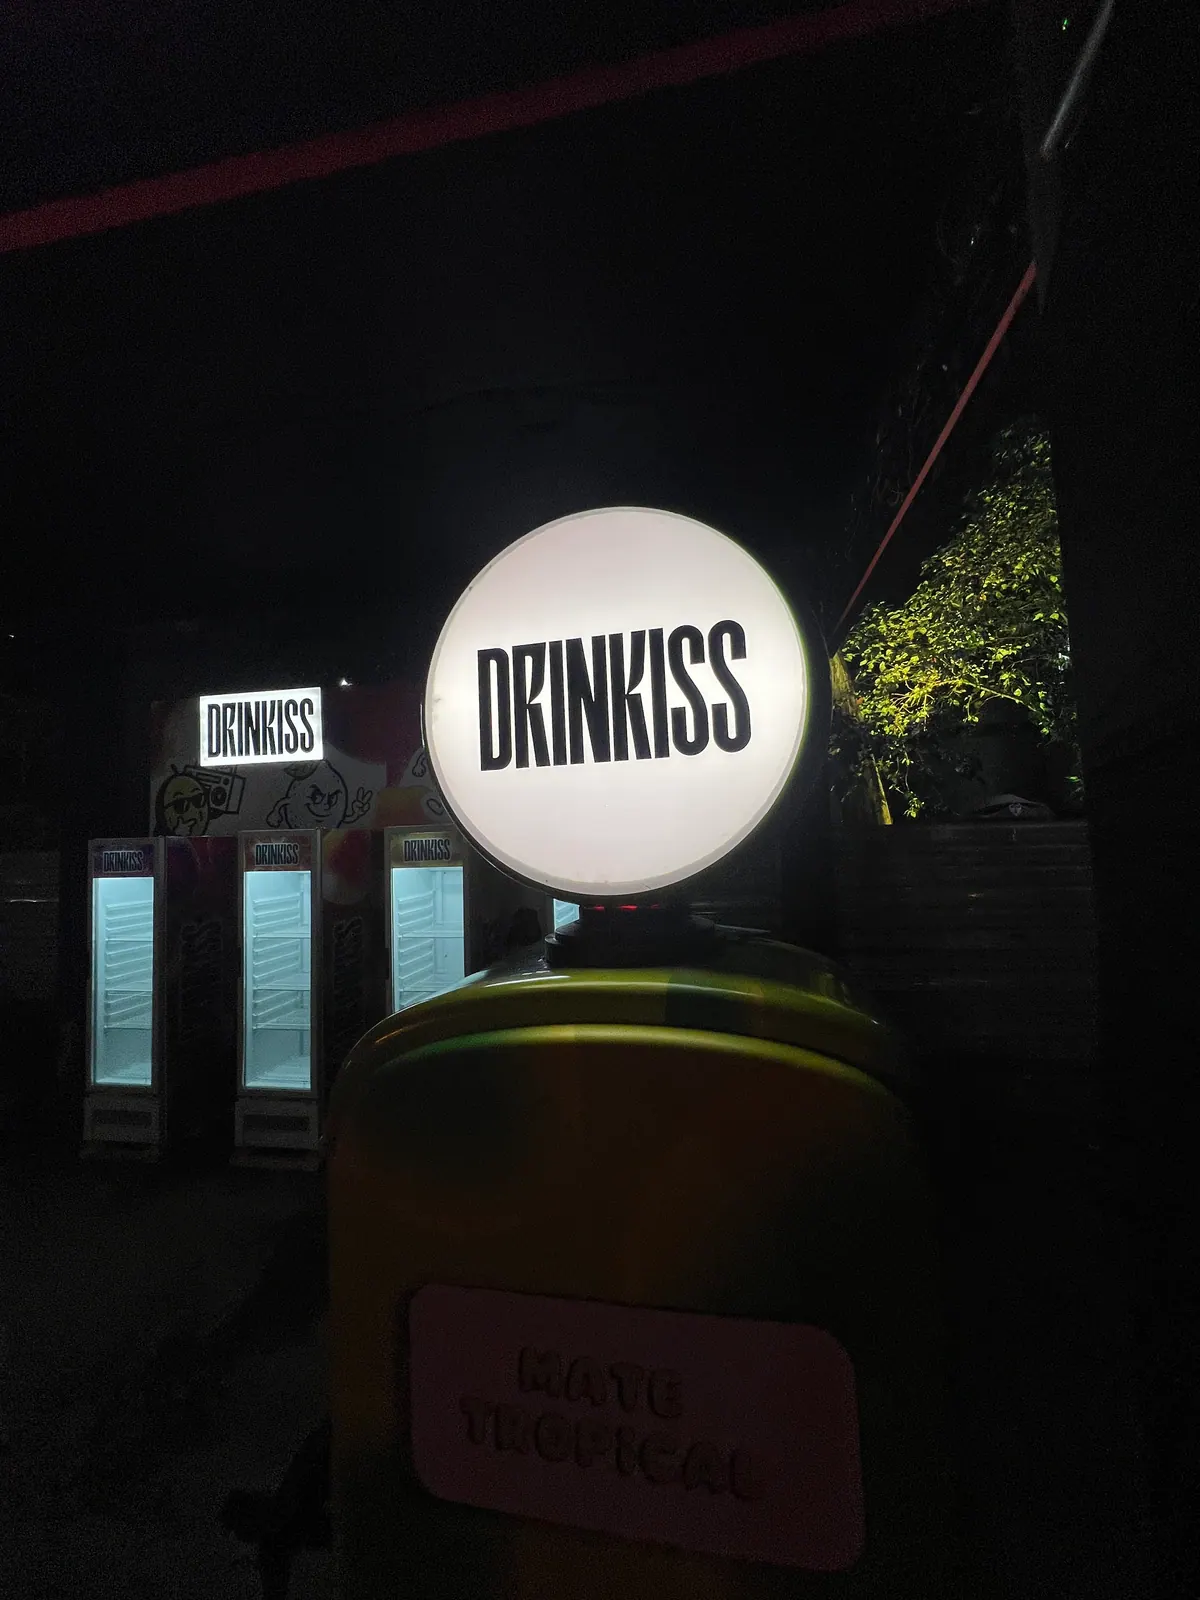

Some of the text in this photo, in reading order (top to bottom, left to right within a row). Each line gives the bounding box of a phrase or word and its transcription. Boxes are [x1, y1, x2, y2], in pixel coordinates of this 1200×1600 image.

[477, 619, 752, 772] DRINKISS
[207, 697, 315, 758] DRINKISS
[103, 850, 145, 873] DRINKISS
[254, 842, 300, 866] DRINKISS
[403, 838, 451, 862] DRINKISS
[517, 1345, 683, 1420] MATE
